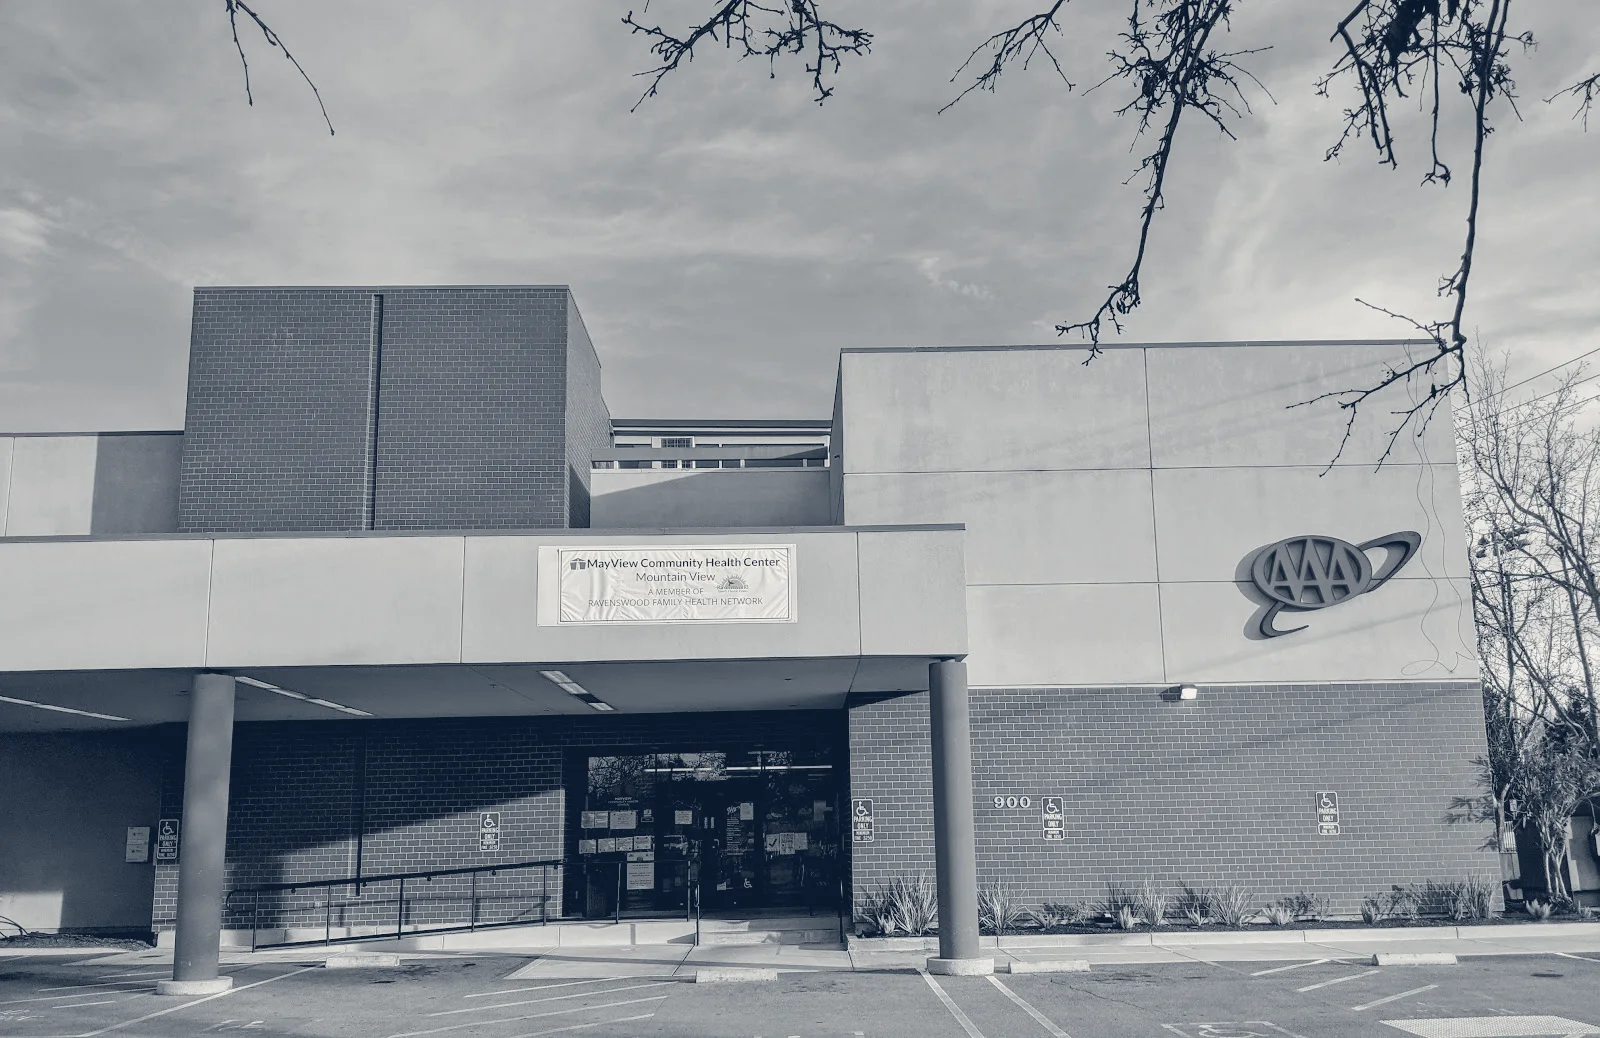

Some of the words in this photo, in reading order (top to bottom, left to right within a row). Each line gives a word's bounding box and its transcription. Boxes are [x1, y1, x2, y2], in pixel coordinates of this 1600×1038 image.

[587, 558, 638, 570] MayView
[641, 558, 703, 568] Community
[706, 557, 742, 567] Health
[744, 558, 780, 567] Center
[1258, 536, 1366, 605] AAA
[636, 572, 686, 582] Mountain
[690, 572, 716, 582] View
[648, 588, 654, 596] A
[656, 588, 691, 596] MEMBER
[588, 599, 650, 607] RAVENSWOOD
[993, 796, 1031, 808] 900
